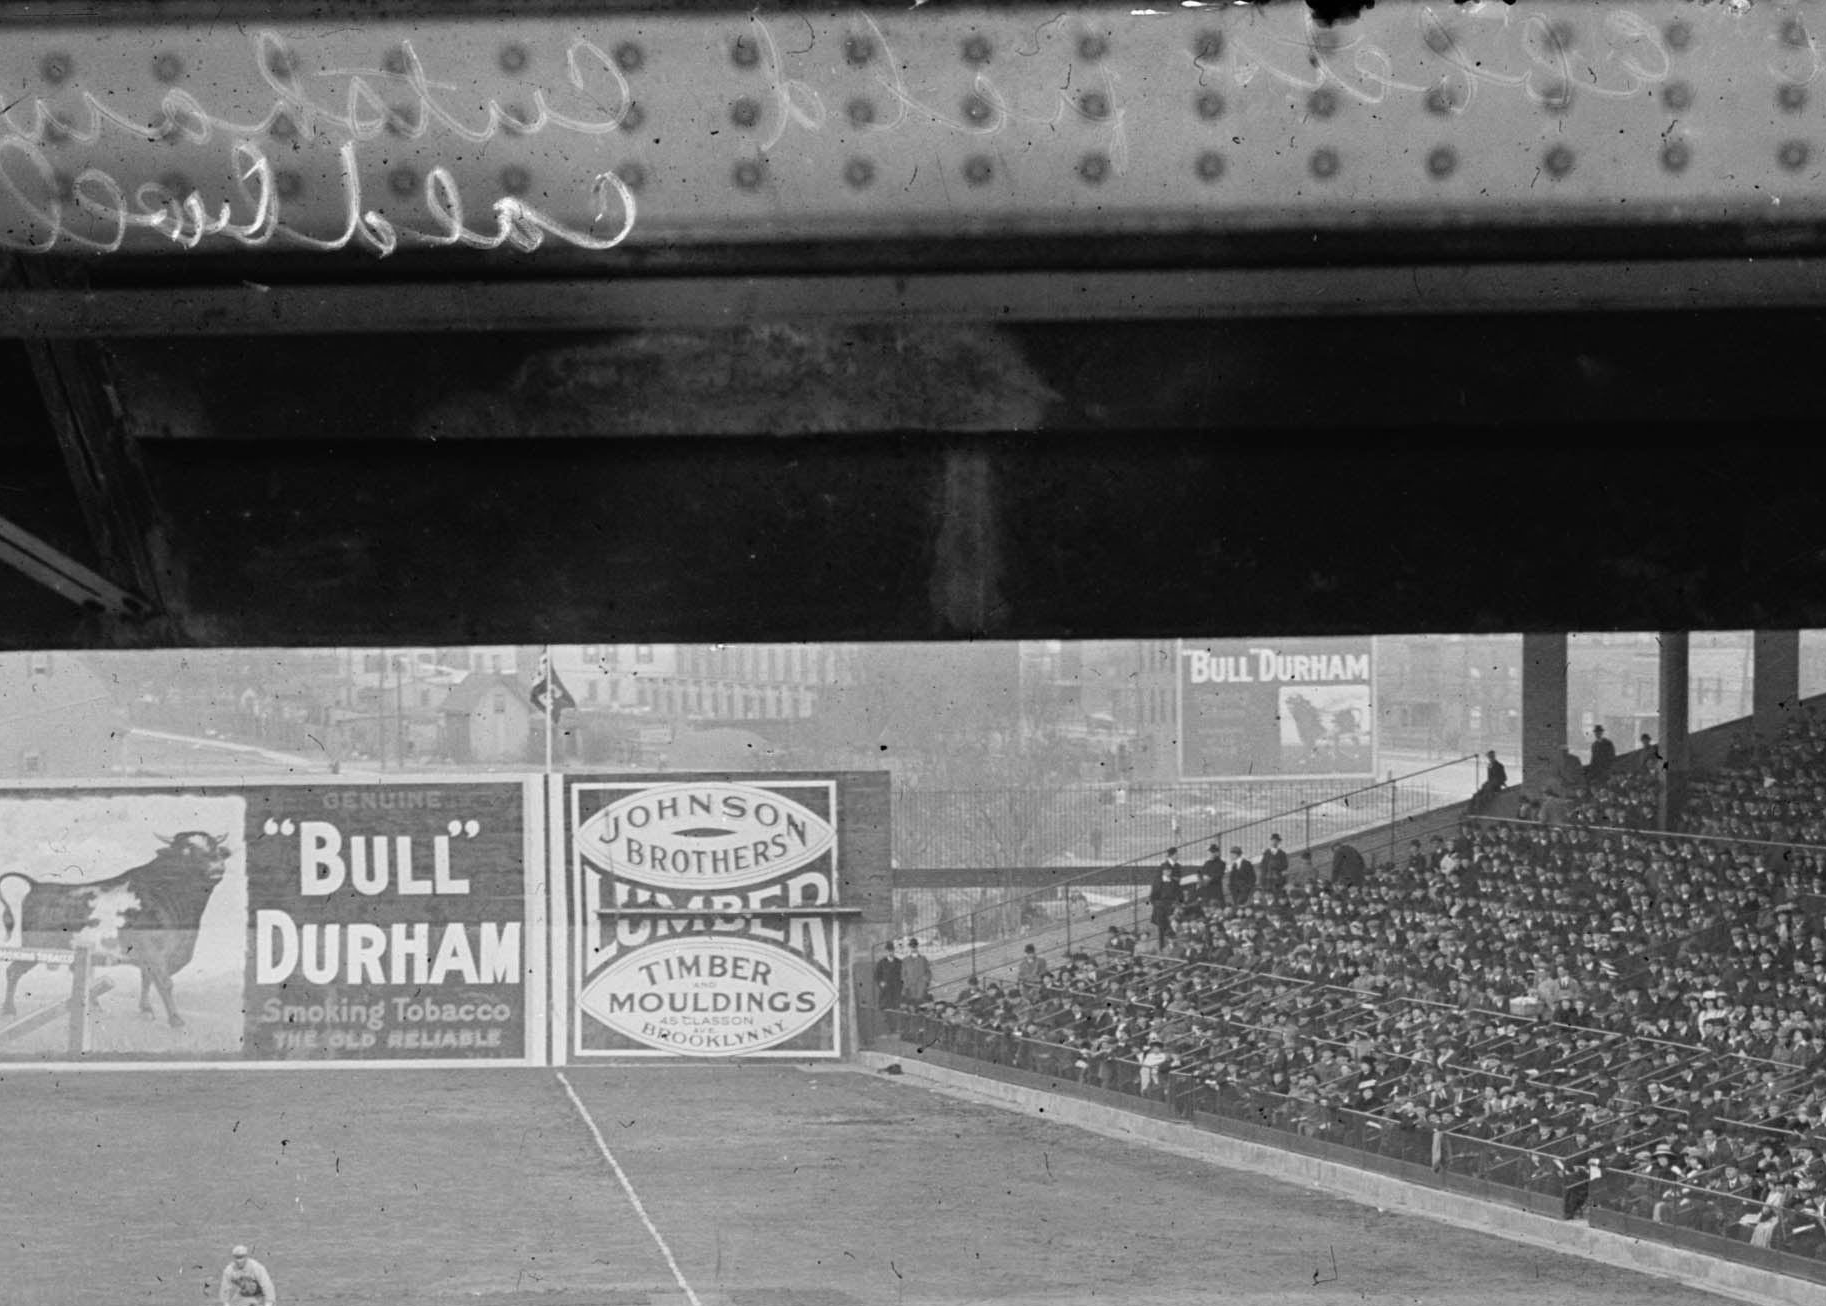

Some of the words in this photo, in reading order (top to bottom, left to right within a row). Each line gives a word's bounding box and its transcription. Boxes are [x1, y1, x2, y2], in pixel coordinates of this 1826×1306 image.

[1259, 648, 1370, 682] DURHAM
[598, 793, 807, 847] JOHNSON
[625, 834, 788, 874] BROTHERS
[583, 865, 833, 978] LUMBER
[255, 909, 523, 985] DURHAM
[638, 954, 772, 986] TIMBER
[262, 998, 385, 1031] Smoking
[390, 997, 511, 1022] Tobacco
[609, 992, 816, 1014] MOULDINGS
[274, 1030, 318, 1049] THE
[328, 1029, 377, 1049] OLD
[386, 1028, 502, 1049] RELIABLE
[641, 1022, 759, 1048] BROOKLYN
